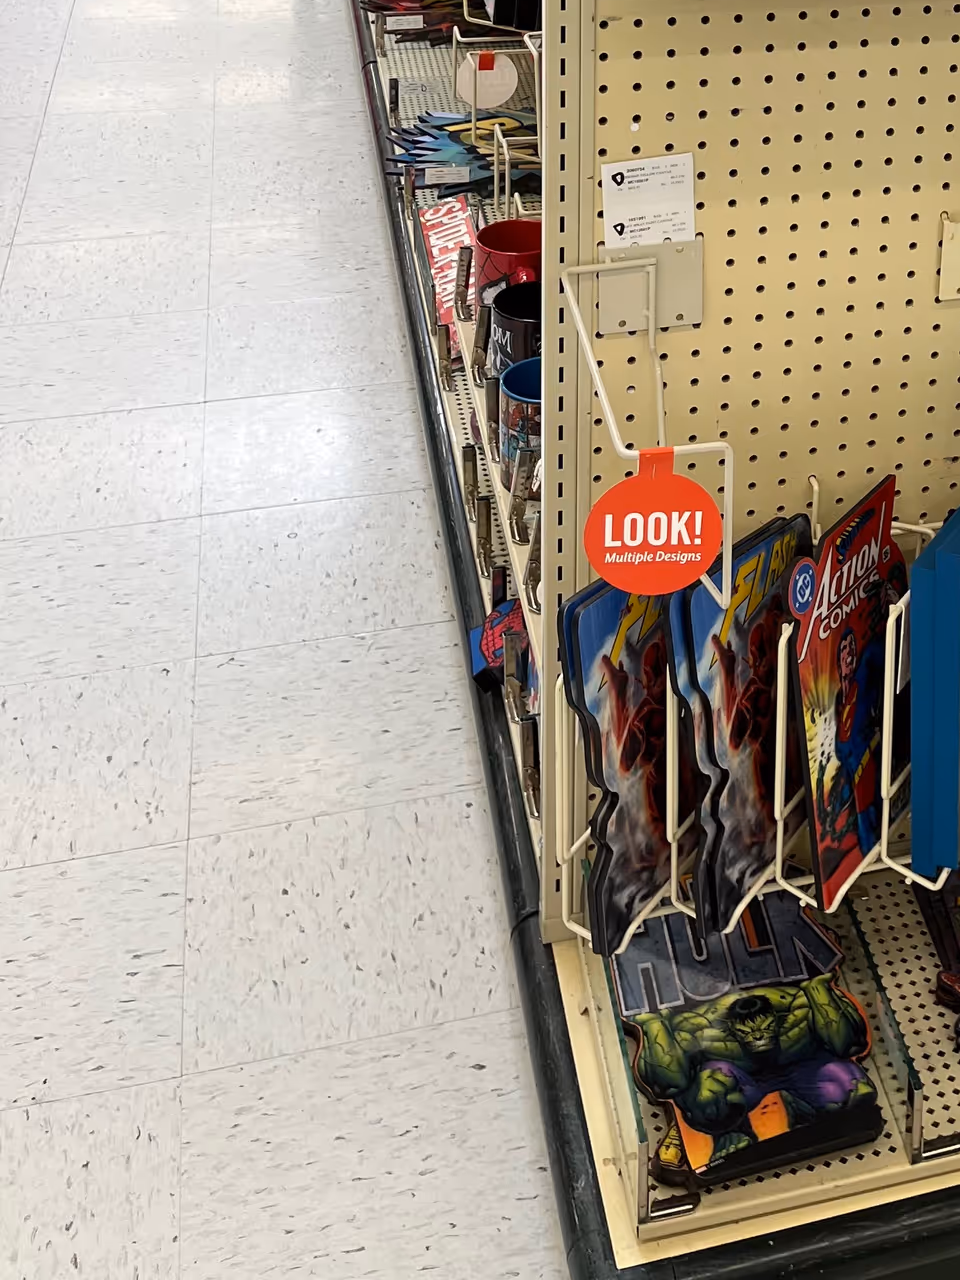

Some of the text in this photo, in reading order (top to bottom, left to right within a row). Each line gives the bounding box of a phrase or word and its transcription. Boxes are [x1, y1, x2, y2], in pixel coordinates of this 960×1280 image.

[604, 511, 703, 548] LOOK!
[604, 550, 702, 565] Multiple Designs
[798, 501, 886, 663] ACTION
